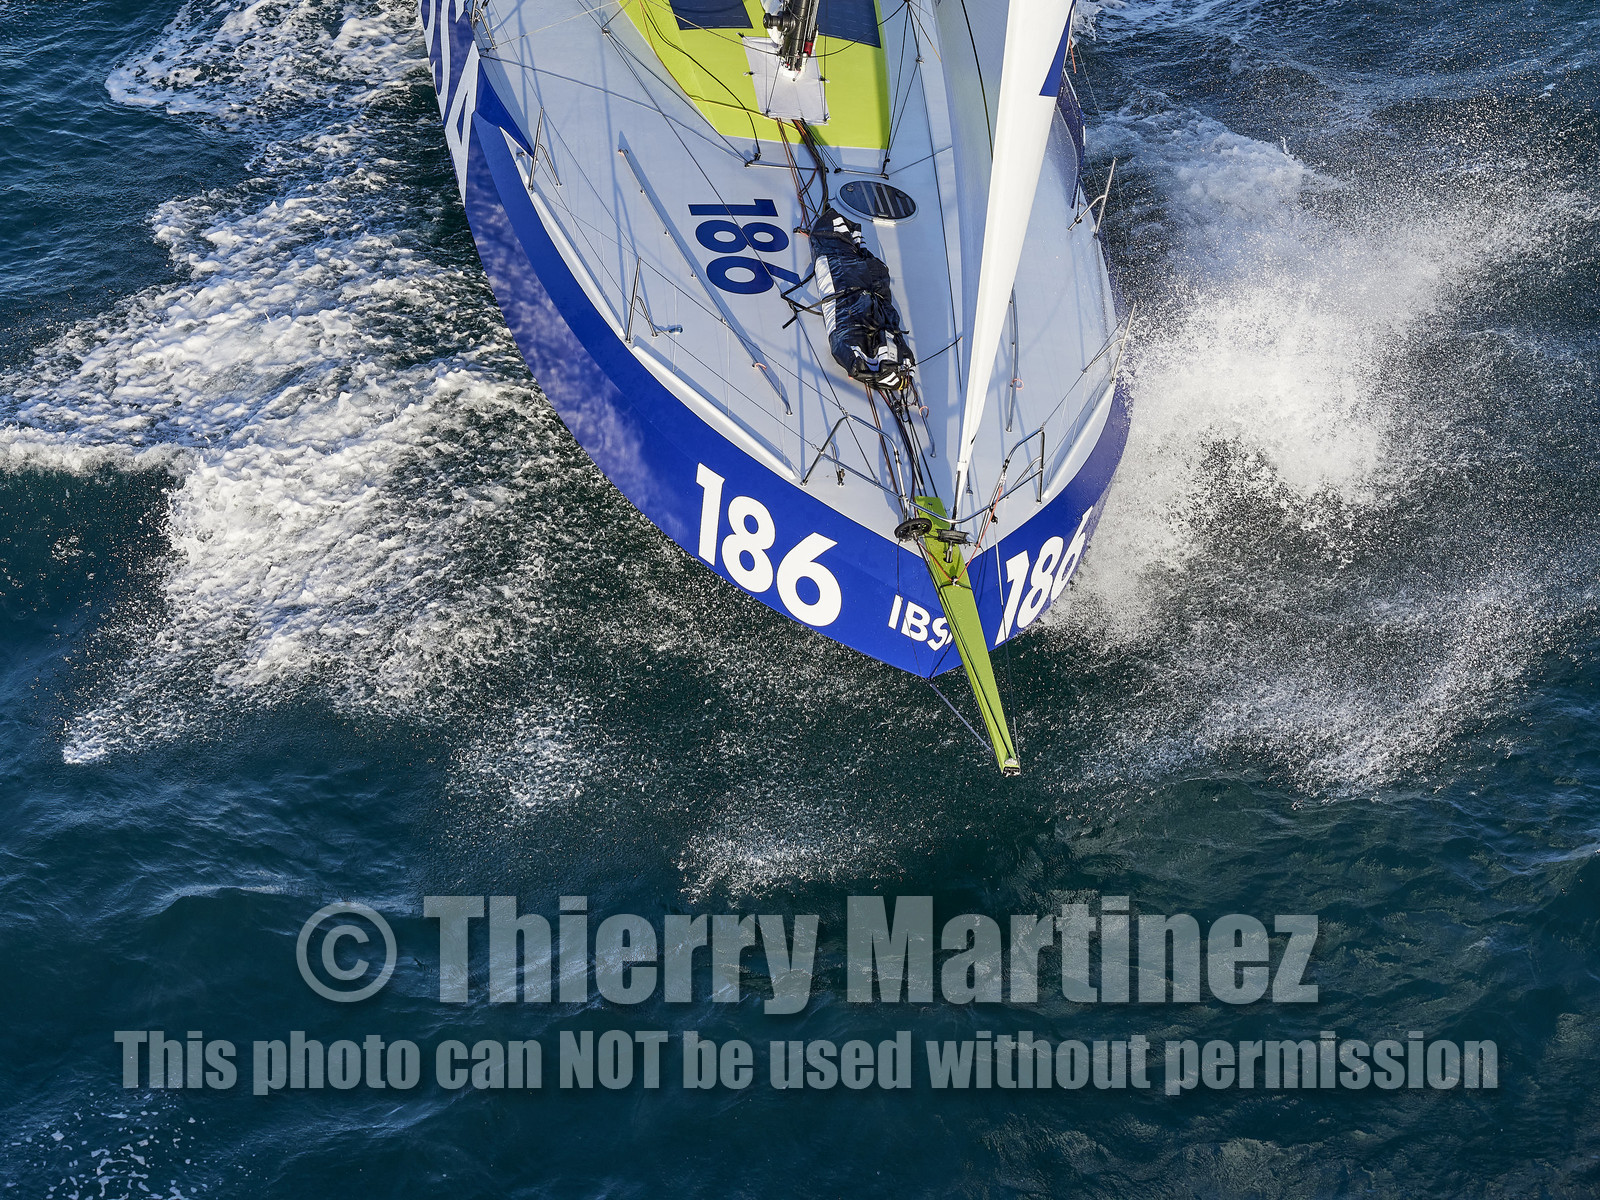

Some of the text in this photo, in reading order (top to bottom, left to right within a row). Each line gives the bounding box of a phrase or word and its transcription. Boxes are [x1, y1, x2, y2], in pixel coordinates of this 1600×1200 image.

[688, 198, 803, 295] 186
[696, 462, 842, 627] 186
[994, 505, 1093, 646] 186
[888, 594, 953, 651] IBS
